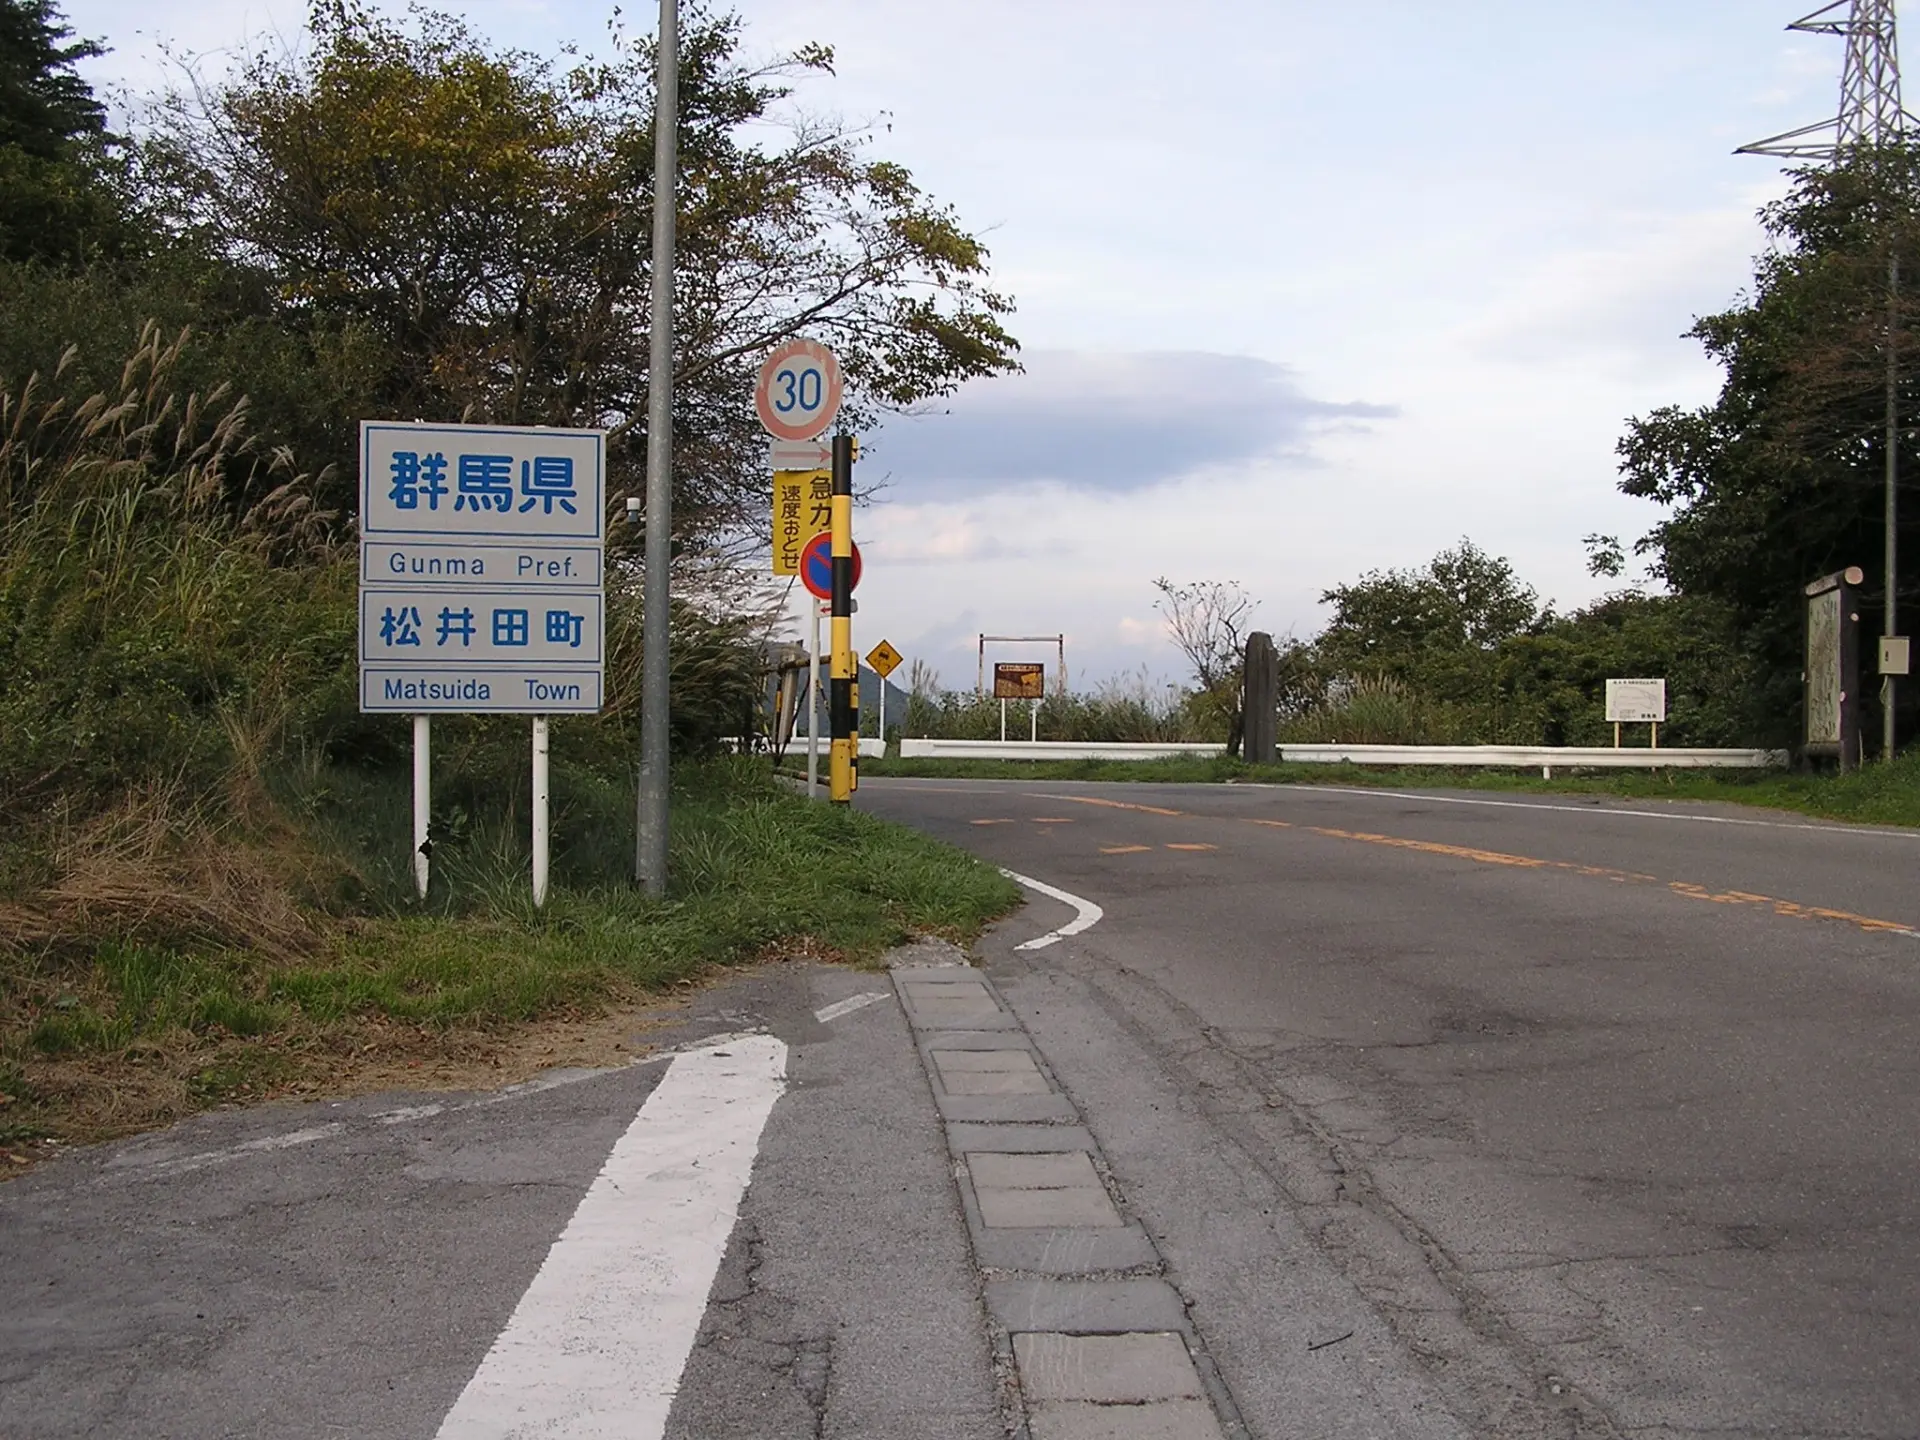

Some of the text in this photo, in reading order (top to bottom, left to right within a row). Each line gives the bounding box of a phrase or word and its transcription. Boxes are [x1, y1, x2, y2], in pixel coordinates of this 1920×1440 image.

[775, 368, 821, 412] 30
[389, 452, 577, 515] 群馬県
[781, 485, 801, 569] 速度おとせ
[389, 552, 578, 577] Gunma Pref.
[379, 606, 585, 648] 松井田町
[384, 678, 580, 702] Matsuida Town
